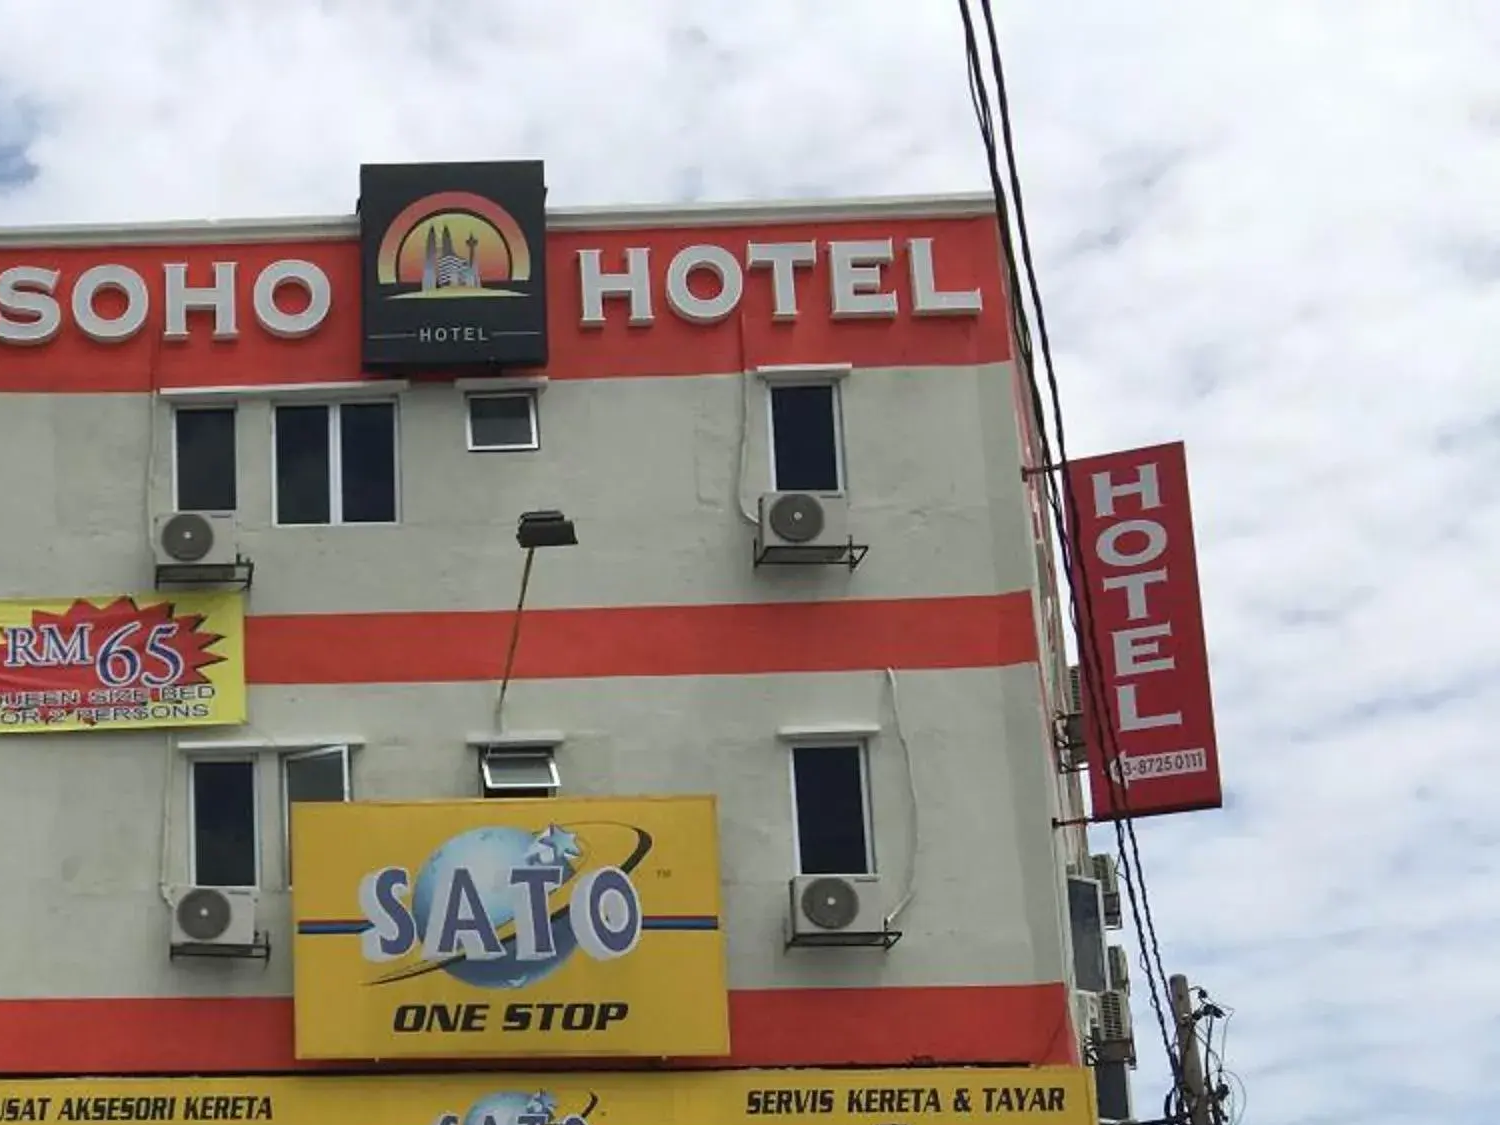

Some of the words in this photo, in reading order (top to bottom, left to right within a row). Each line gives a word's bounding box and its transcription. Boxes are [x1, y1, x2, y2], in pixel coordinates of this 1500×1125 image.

[576, 238, 982, 328] HOTEL
[418, 327, 489, 343] HOTEL
[1091, 462, 1181, 732] HOTEL
[89, 687, 145, 705] SIZE
[159, 684, 215, 701] BED
[76, 702, 209, 723] PERSONS
[357, 864, 644, 964] SATO
[393, 1003, 490, 1033] ONE
[502, 1002, 629, 1032] STOP
[57, 1096, 176, 1122] AKSESORI
[183, 1095, 274, 1120] KERETA
[745, 1088, 835, 1115] SERVIS
[846, 1088, 942, 1114] KERETA
[953, 1088, 970, 1113] &
[981, 1086, 1066, 1113] TAYAR
